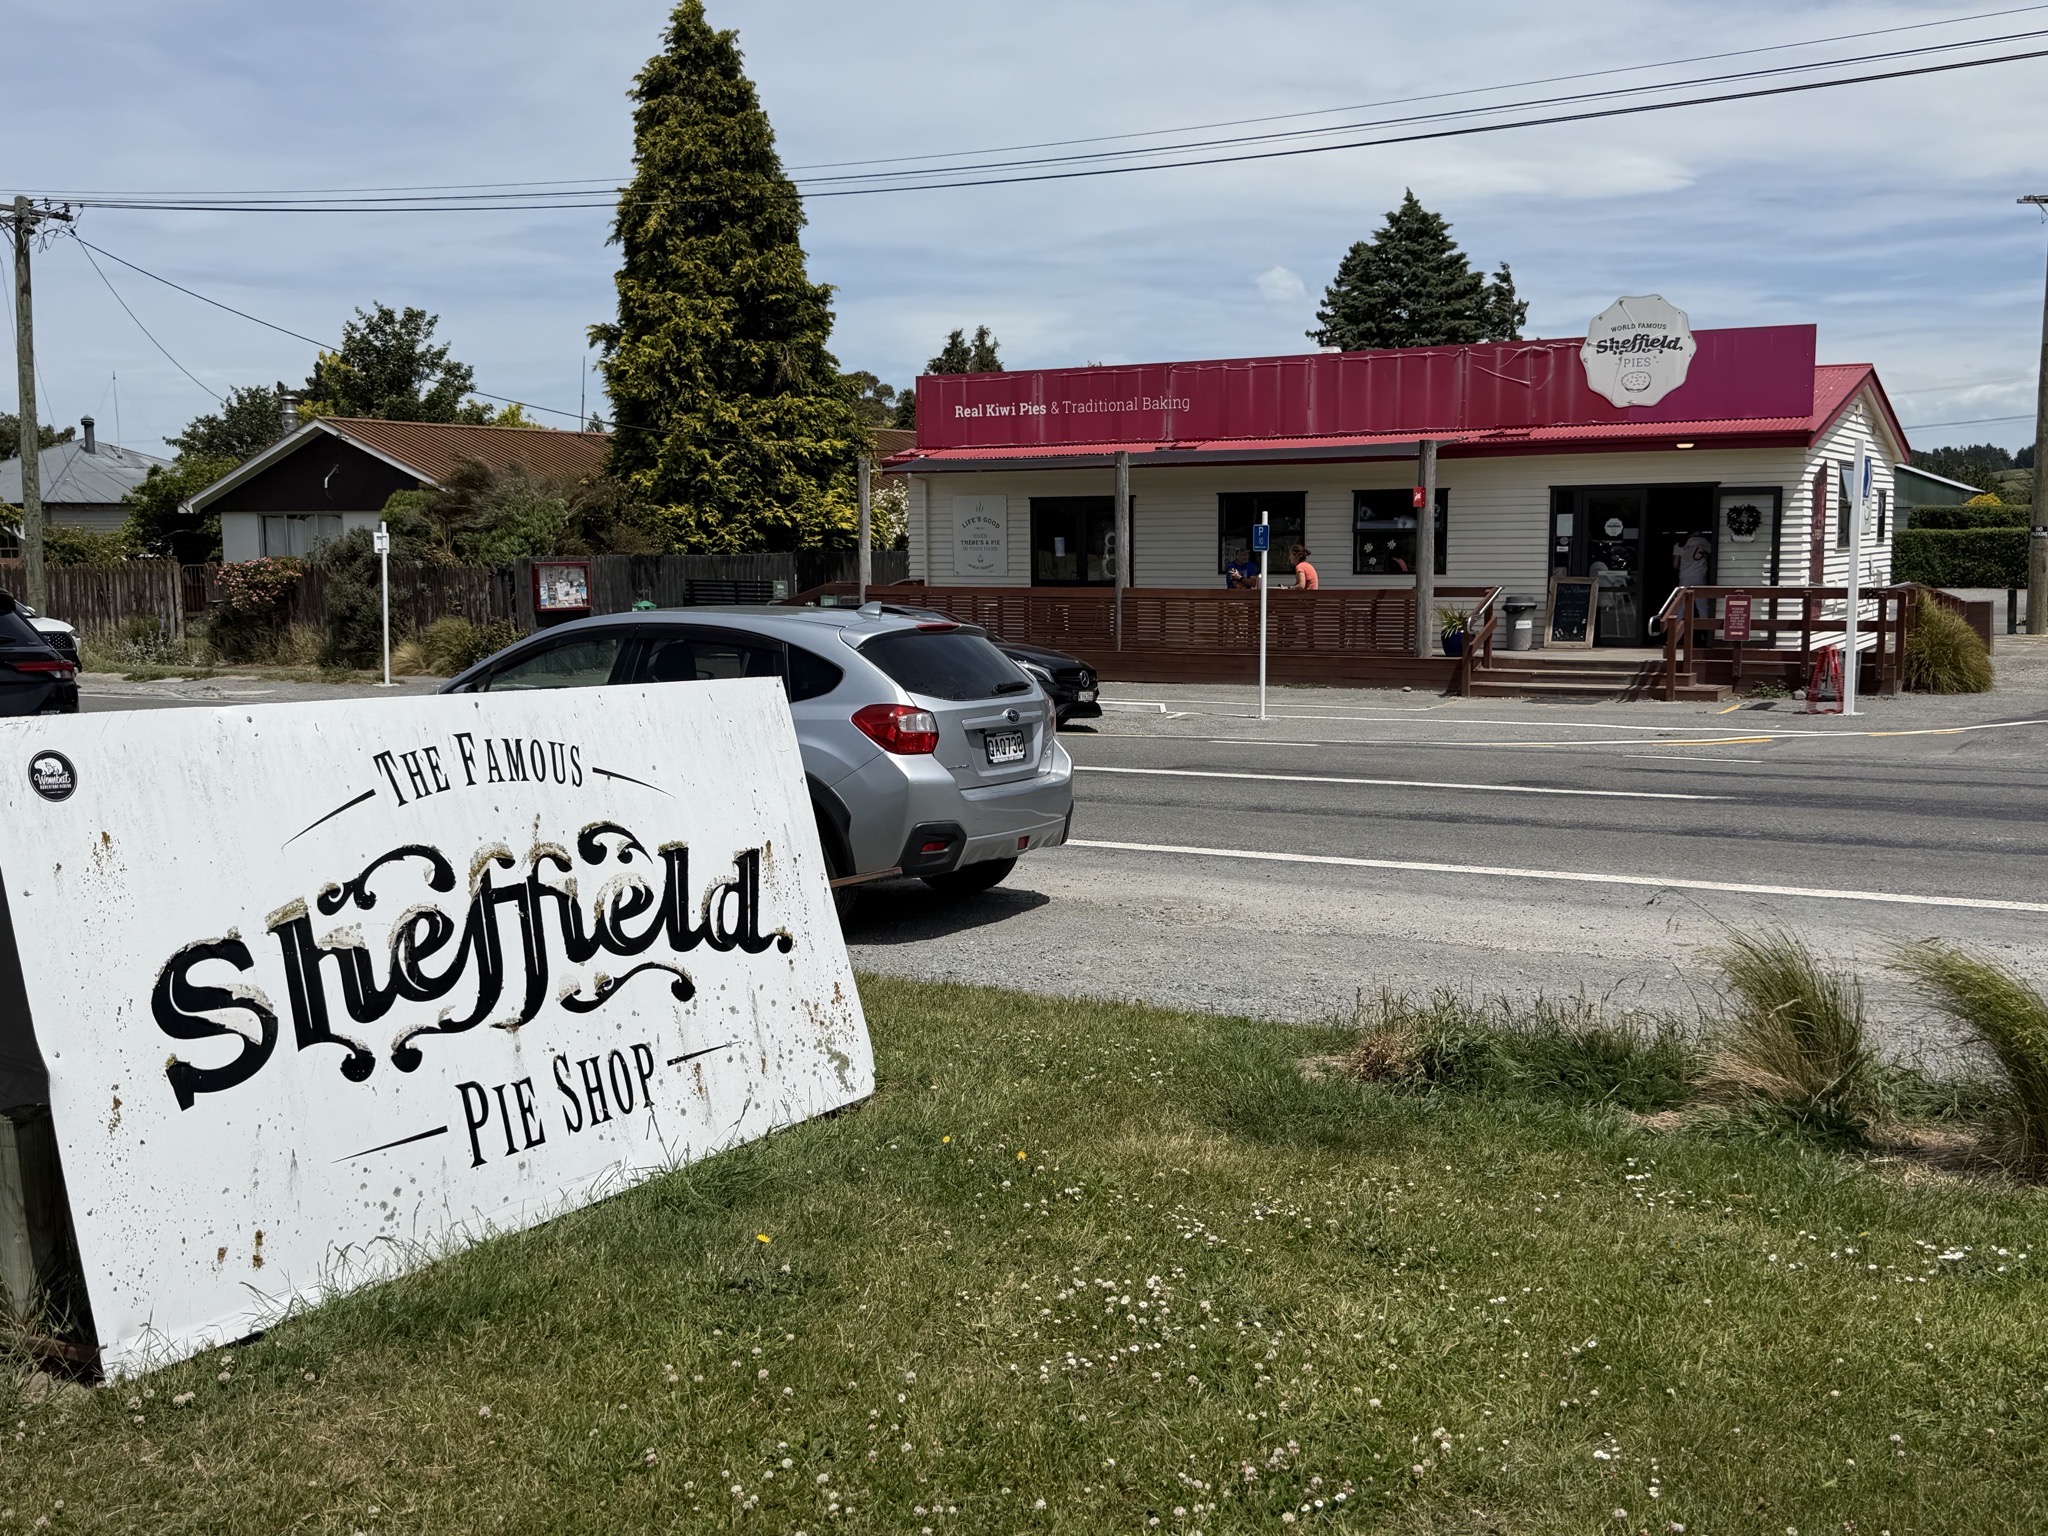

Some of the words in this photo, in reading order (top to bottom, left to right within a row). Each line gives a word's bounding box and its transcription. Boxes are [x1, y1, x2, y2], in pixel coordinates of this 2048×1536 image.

[1611, 323, 1636, 333] WORLD
[1637, 322, 1667, 330] FAMOUS
[1623, 358, 1651, 368] PIES
[955, 404, 983, 418] Real
[985, 402, 1016, 417] Kiwi
[1019, 401, 1047, 416] Pies
[1050, 401, 1060, 415] &
[1062, 396, 1138, 414] Traditional
[1142, 395, 1190, 412] Baking
[961, 516, 982, 529] LIFE'S
[983, 516, 1000, 529] GOOD
[1258, 526, 1264, 536] P
[372, 745, 451, 807] THE
[452, 732, 583, 788] FAMOUS
[33, 771, 71, 784] Wombat
[454, 1076, 547, 1169] PIE
[552, 1043, 655, 1136] SHOP
